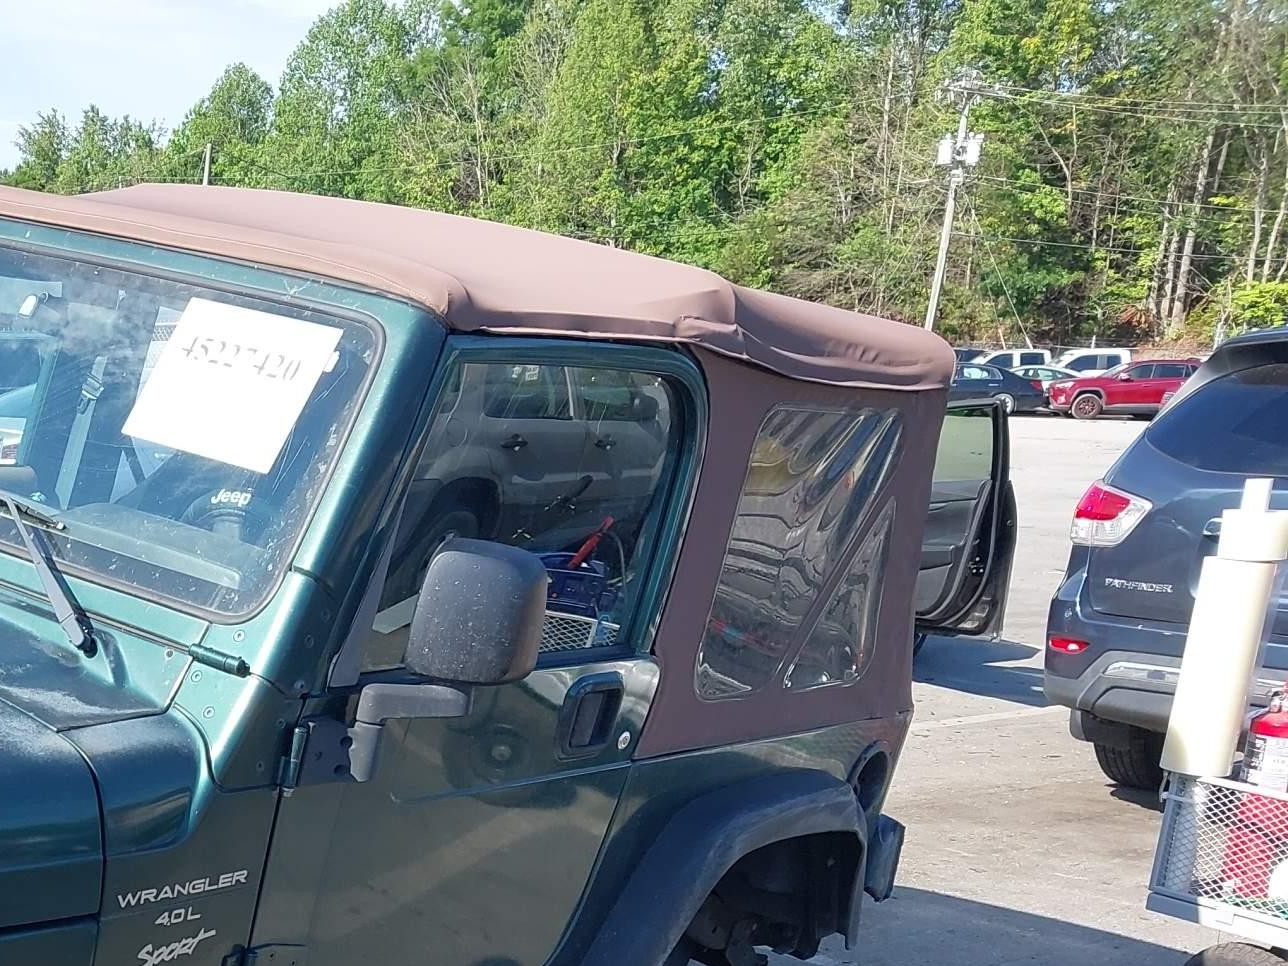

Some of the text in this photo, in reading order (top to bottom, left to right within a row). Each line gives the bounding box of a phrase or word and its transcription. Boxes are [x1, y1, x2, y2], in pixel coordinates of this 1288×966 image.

[182, 335, 302, 382] 45227420
[210, 487, 253, 507] Jeep
[1104, 577, 1175, 594] PATHFINDER
[117, 869, 249, 909] WRANGLER
